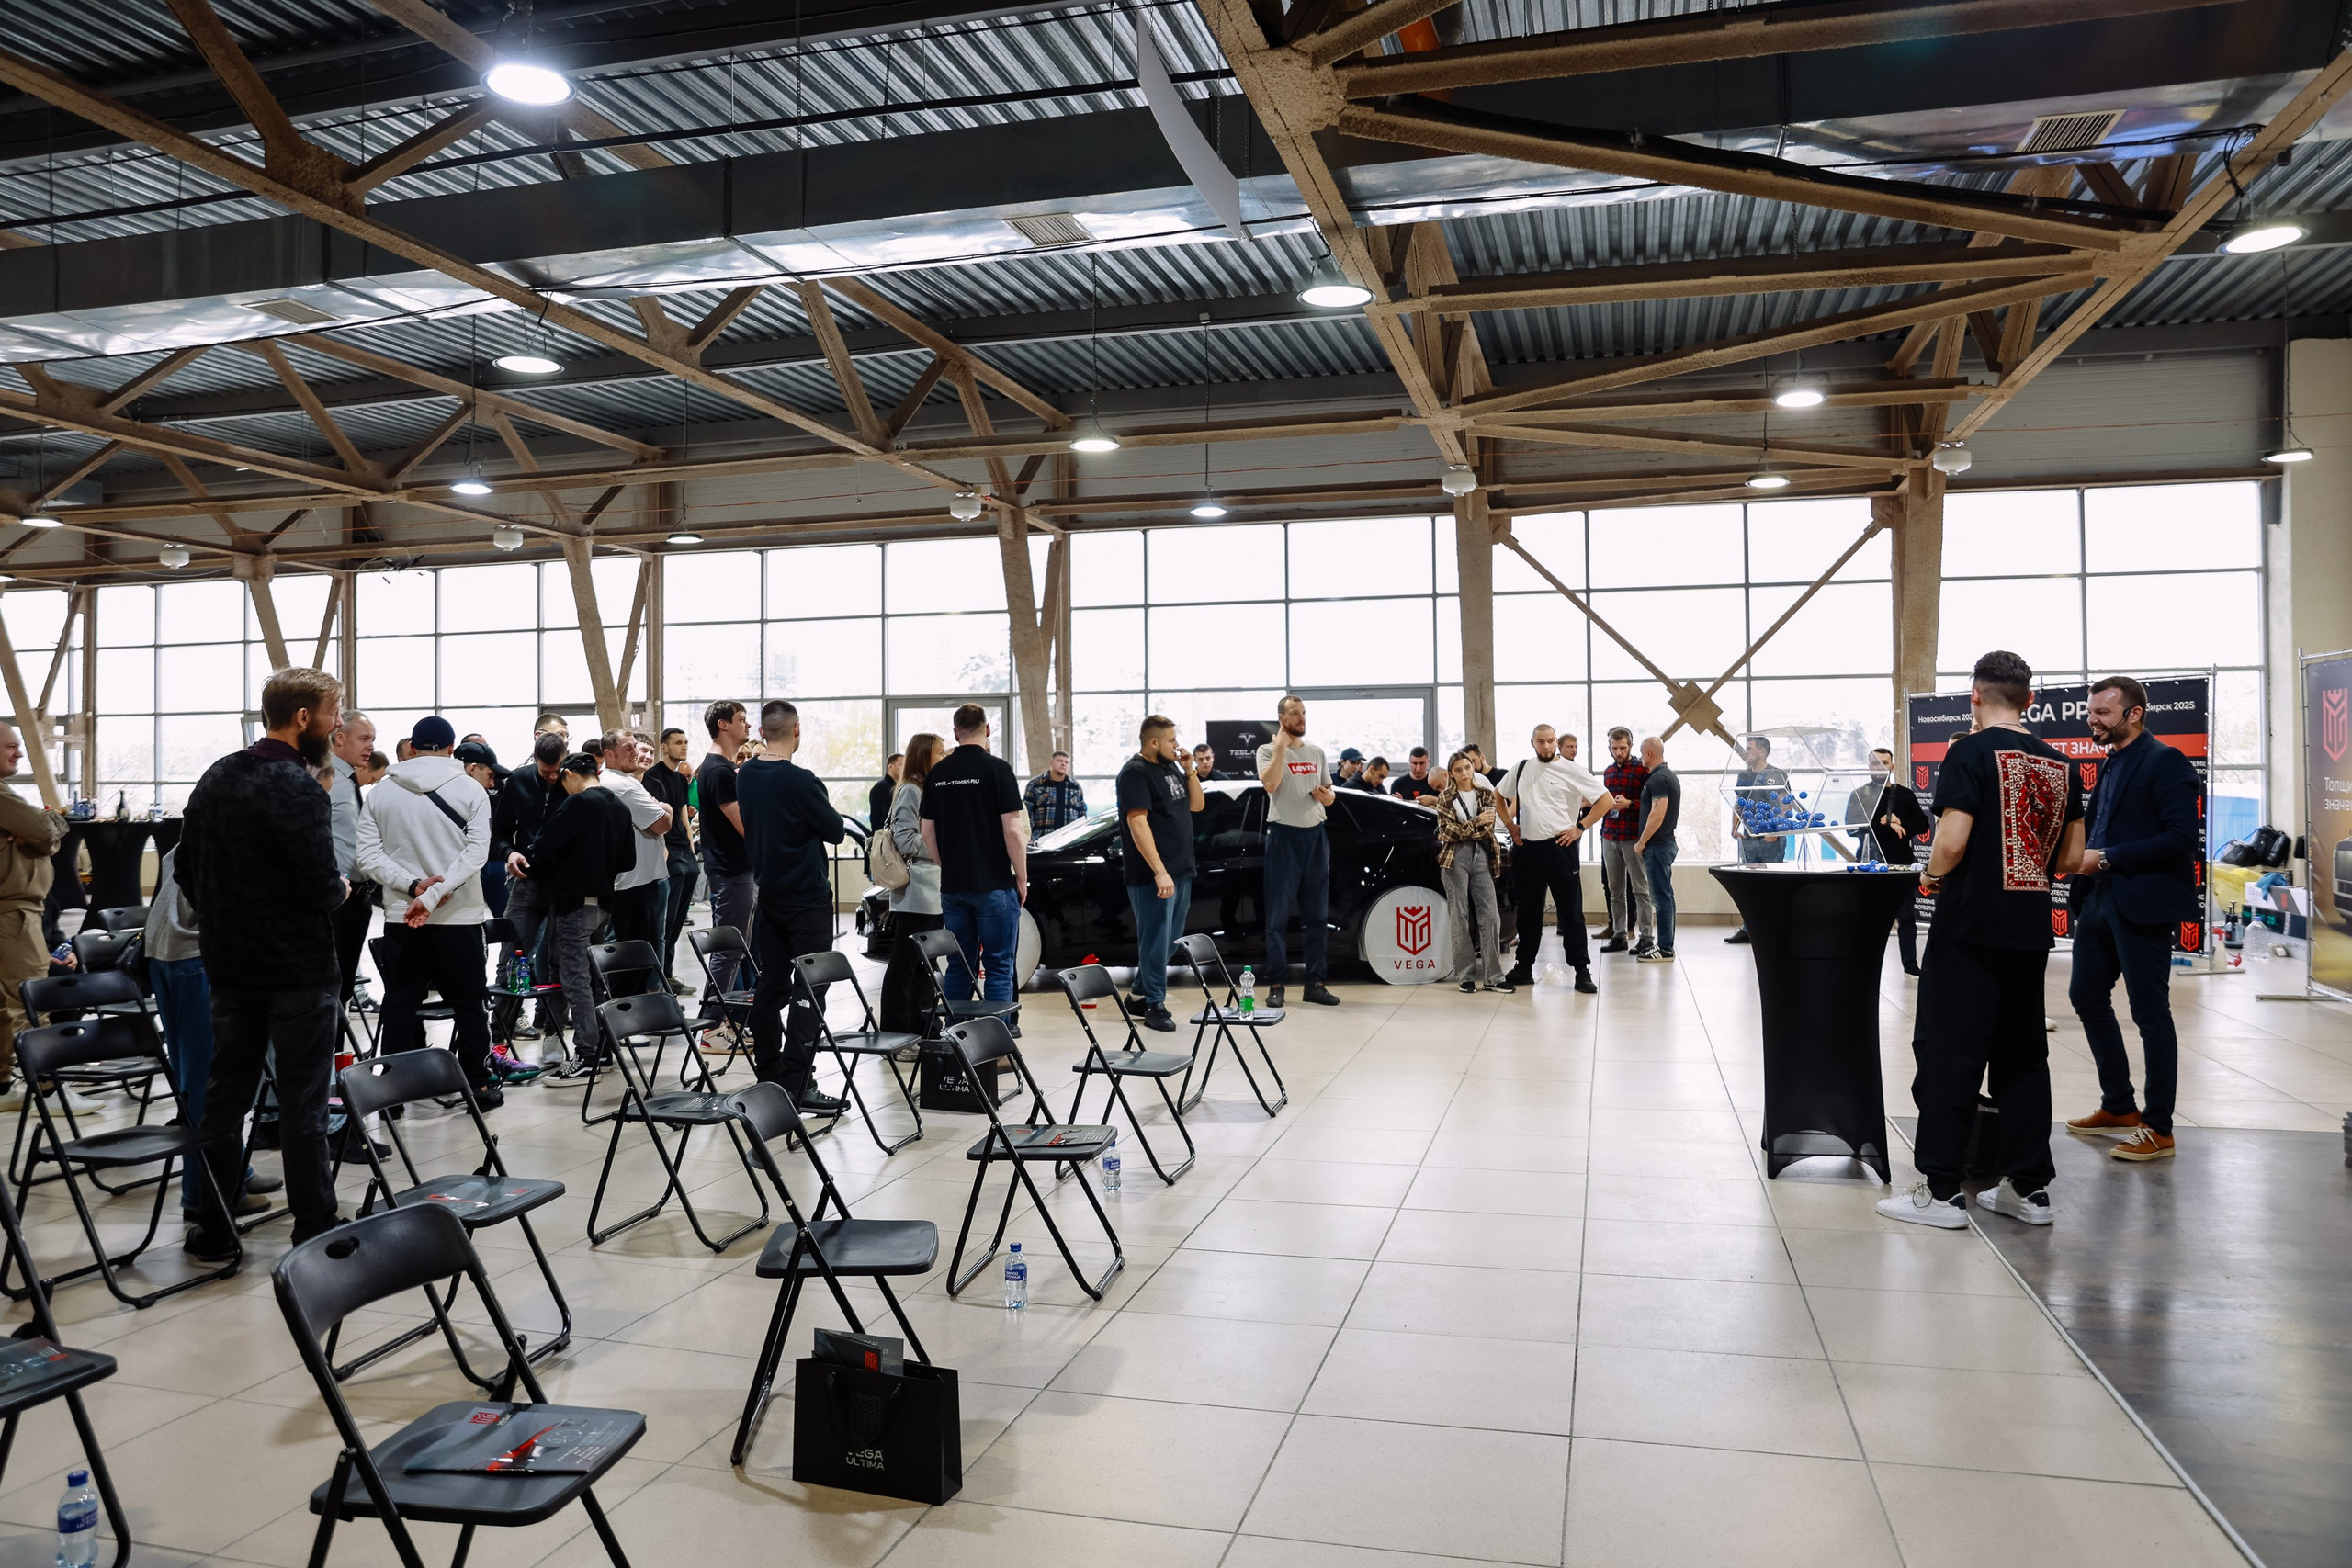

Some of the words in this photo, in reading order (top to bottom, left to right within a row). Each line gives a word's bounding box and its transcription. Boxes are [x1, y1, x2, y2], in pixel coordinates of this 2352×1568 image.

[2062, 701, 2088, 721] PP
[2173, 700, 2196, 710] 2025
[1917, 714, 1961, 724] Новосибирск
[2324, 777, 2352, 793] Толщи
[2324, 798, 2352, 810] значе
[1394, 959, 1436, 970] VEGA
[845, 1456, 885, 1470] ULTIMA
